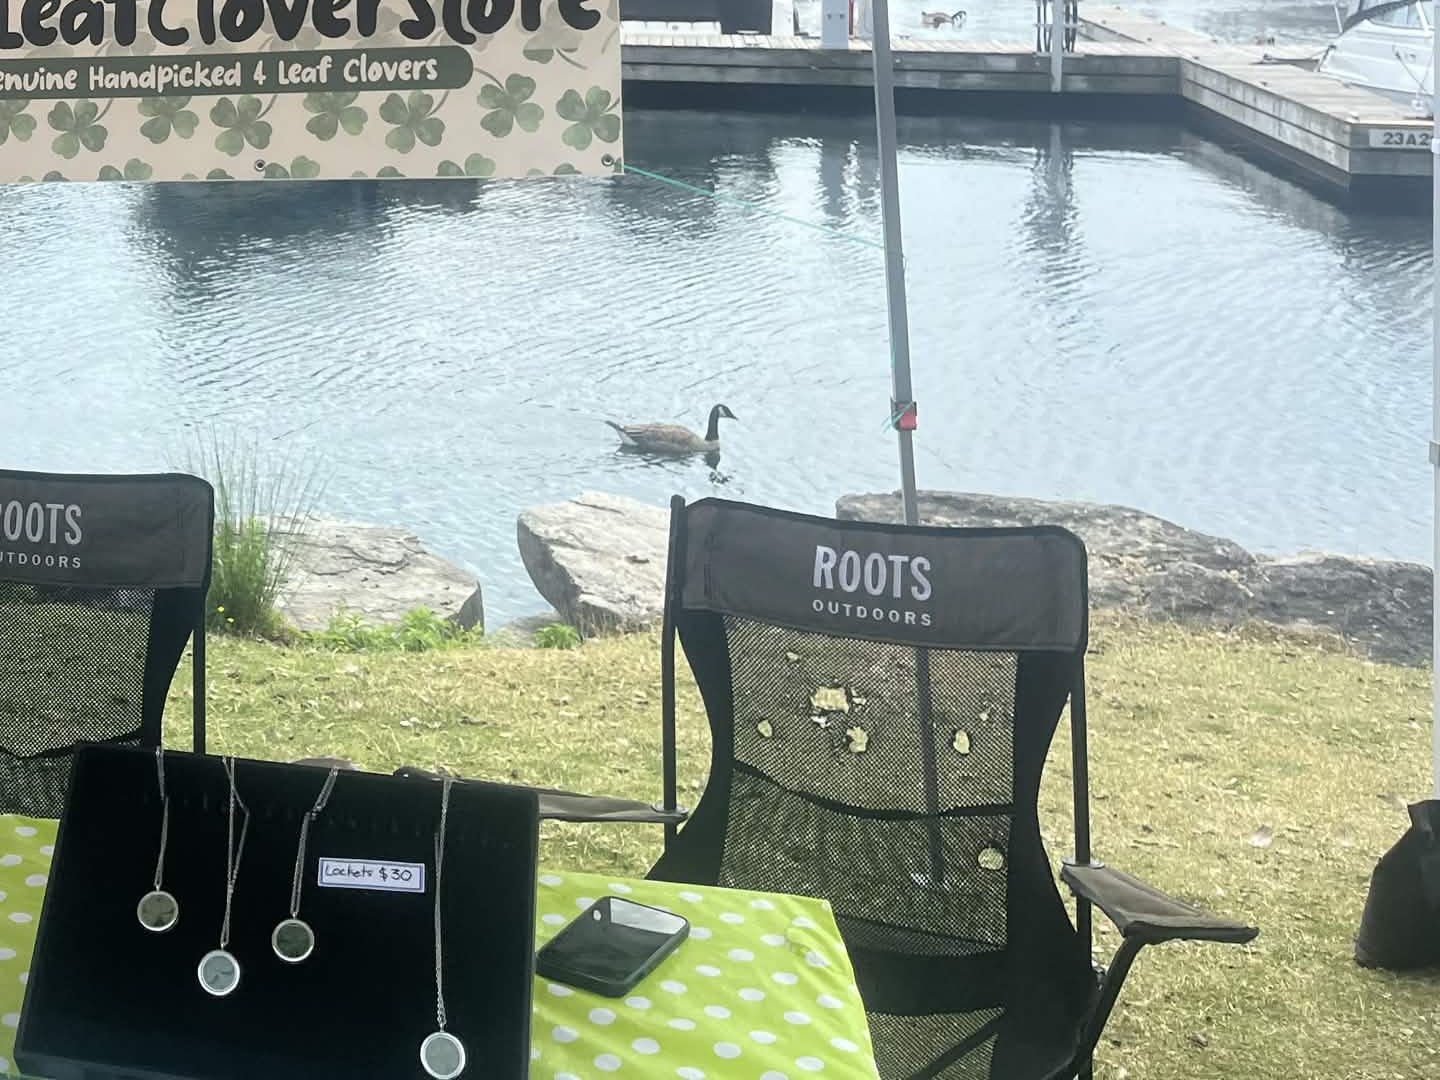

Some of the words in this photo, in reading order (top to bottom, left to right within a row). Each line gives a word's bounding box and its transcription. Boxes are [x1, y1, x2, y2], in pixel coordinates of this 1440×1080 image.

[88, 60, 242, 94] Handpicked
[252, 59, 267, 86] 4
[278, 55, 333, 86] Leaf
[343, 52, 438, 83] Clovers
[1382, 131, 1431, 147] 23A2
[812, 544, 933, 602] ROOTS
[812, 598, 932, 627] OUTDOORS
[325, 863, 373, 878] Lockets
[379, 866, 412, 883] $30
